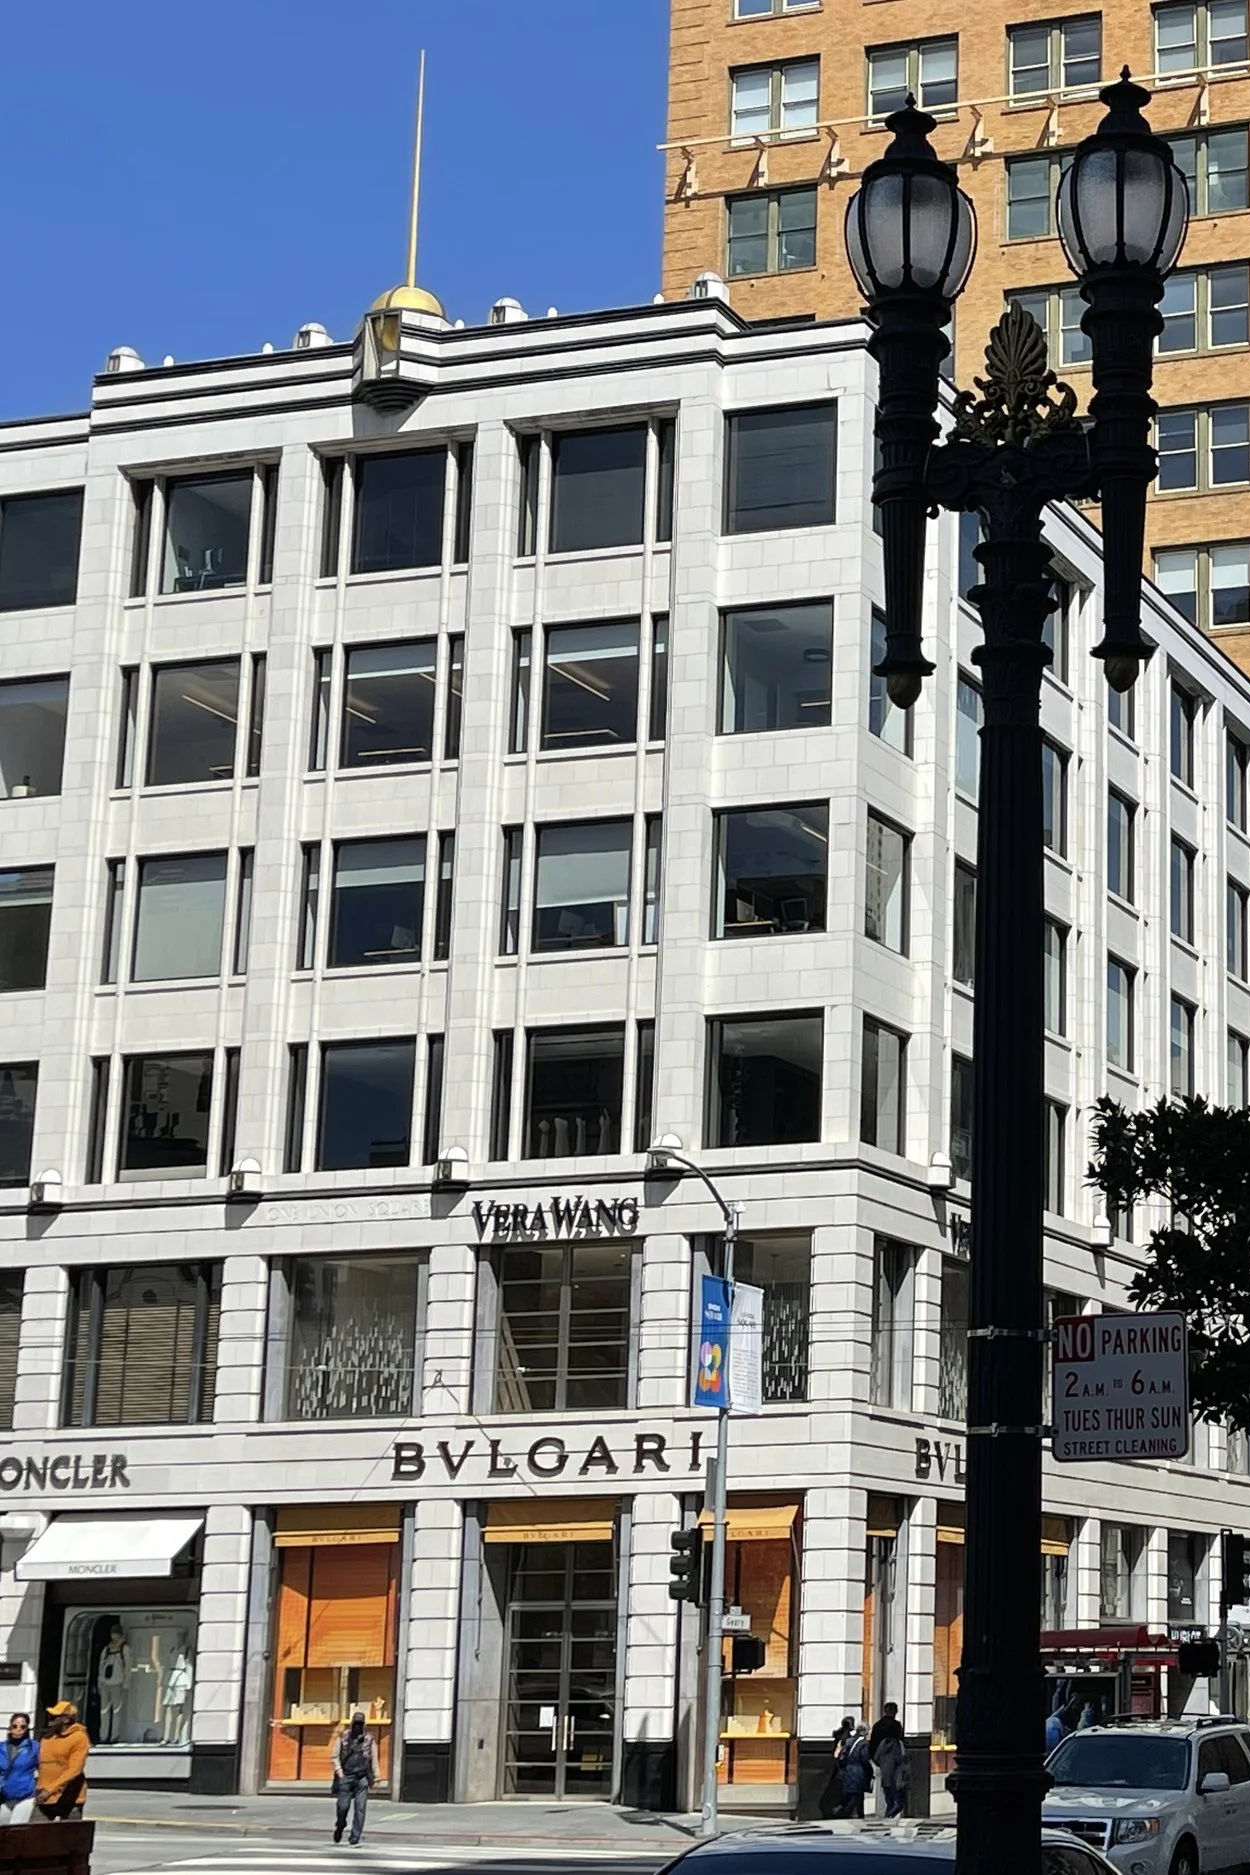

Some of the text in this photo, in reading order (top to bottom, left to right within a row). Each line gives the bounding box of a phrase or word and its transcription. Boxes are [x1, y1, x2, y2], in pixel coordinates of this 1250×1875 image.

[266, 1199, 429, 1222] ONE UNION SQUARE
[473, 1195, 640, 1237] VERA WANG
[1058, 1323, 1182, 1359] NO PARKING
[1065, 1371, 1079, 1398] 2
[1113, 1379, 1123, 1389] TO
[1131, 1369, 1145, 1396] 6
[1063, 1406, 1181, 1432] TUES THUR SUN
[391, 1431, 704, 1482] BVLGARI
[1064, 1438, 1177, 1456] STREET CLEANING
[0, 1454, 131, 1491] ONCLER
[731, 1530, 769, 1538] LGARI
[68, 1564, 118, 1574] MONCLER
